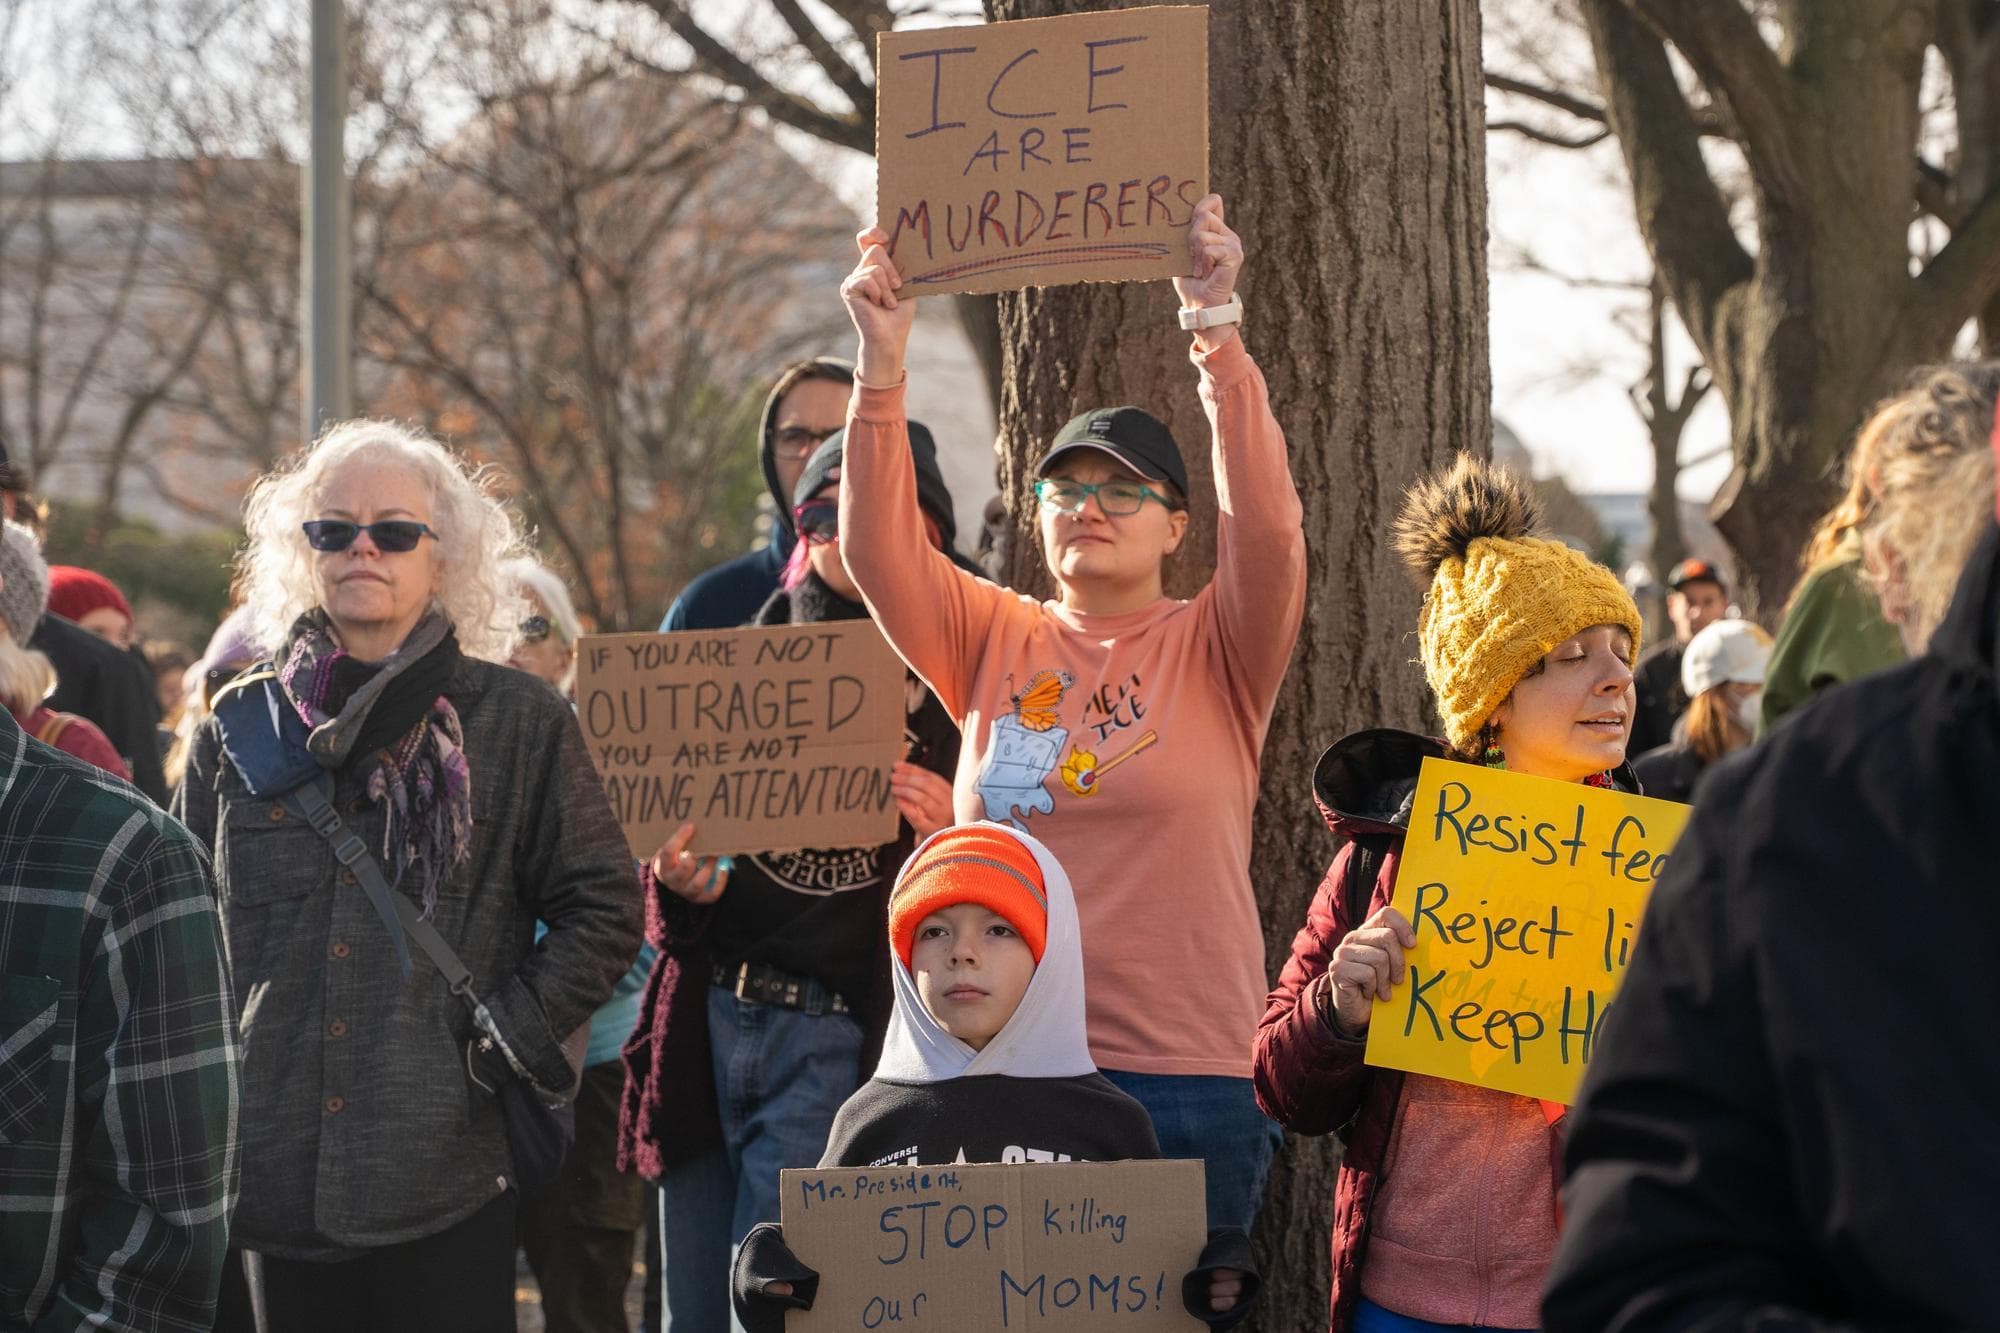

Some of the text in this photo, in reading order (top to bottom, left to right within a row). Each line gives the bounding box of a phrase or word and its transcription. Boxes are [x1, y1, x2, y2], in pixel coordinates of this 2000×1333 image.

[899, 36, 1149, 139] ICE
[963, 127, 1092, 176] ARE
[887, 175, 1197, 260] MURDERERS
[590, 634, 844, 673] IF YOU ARE NOT
[587, 675, 865, 739] OUTRAGED
[599, 735, 808, 769] YOU ARE NOT
[600, 766, 894, 824] AYING ATTENTION
[1434, 781, 1588, 867] Resist
[1411, 882, 1574, 969] Reject
[801, 1178, 846, 1209] Mr.
[878, 1201, 1009, 1265] STOP
[1000, 1270, 1165, 1328] MOMS!
